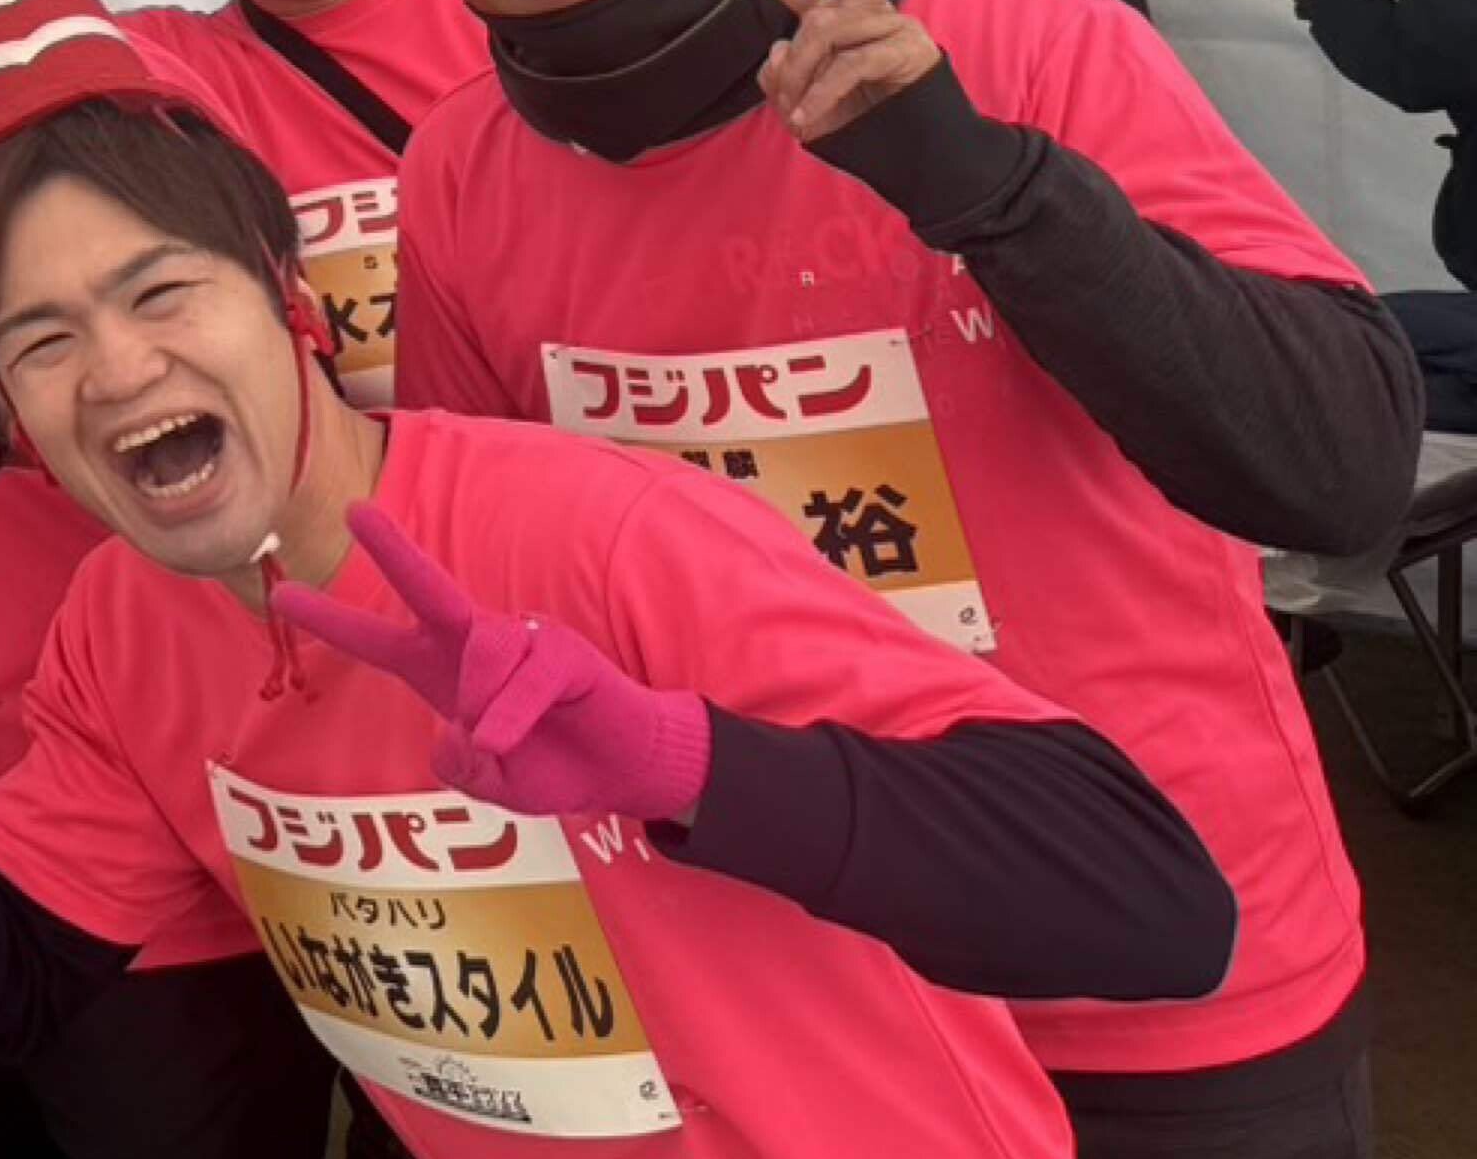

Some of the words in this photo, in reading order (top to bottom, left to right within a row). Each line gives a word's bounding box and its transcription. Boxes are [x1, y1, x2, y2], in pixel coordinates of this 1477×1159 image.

[572, 355, 872, 426] フジパン
[803, 484, 919, 578] 裕
[228, 786, 519, 872] フジパン
[259, 914, 616, 1042] いながきスタイル
